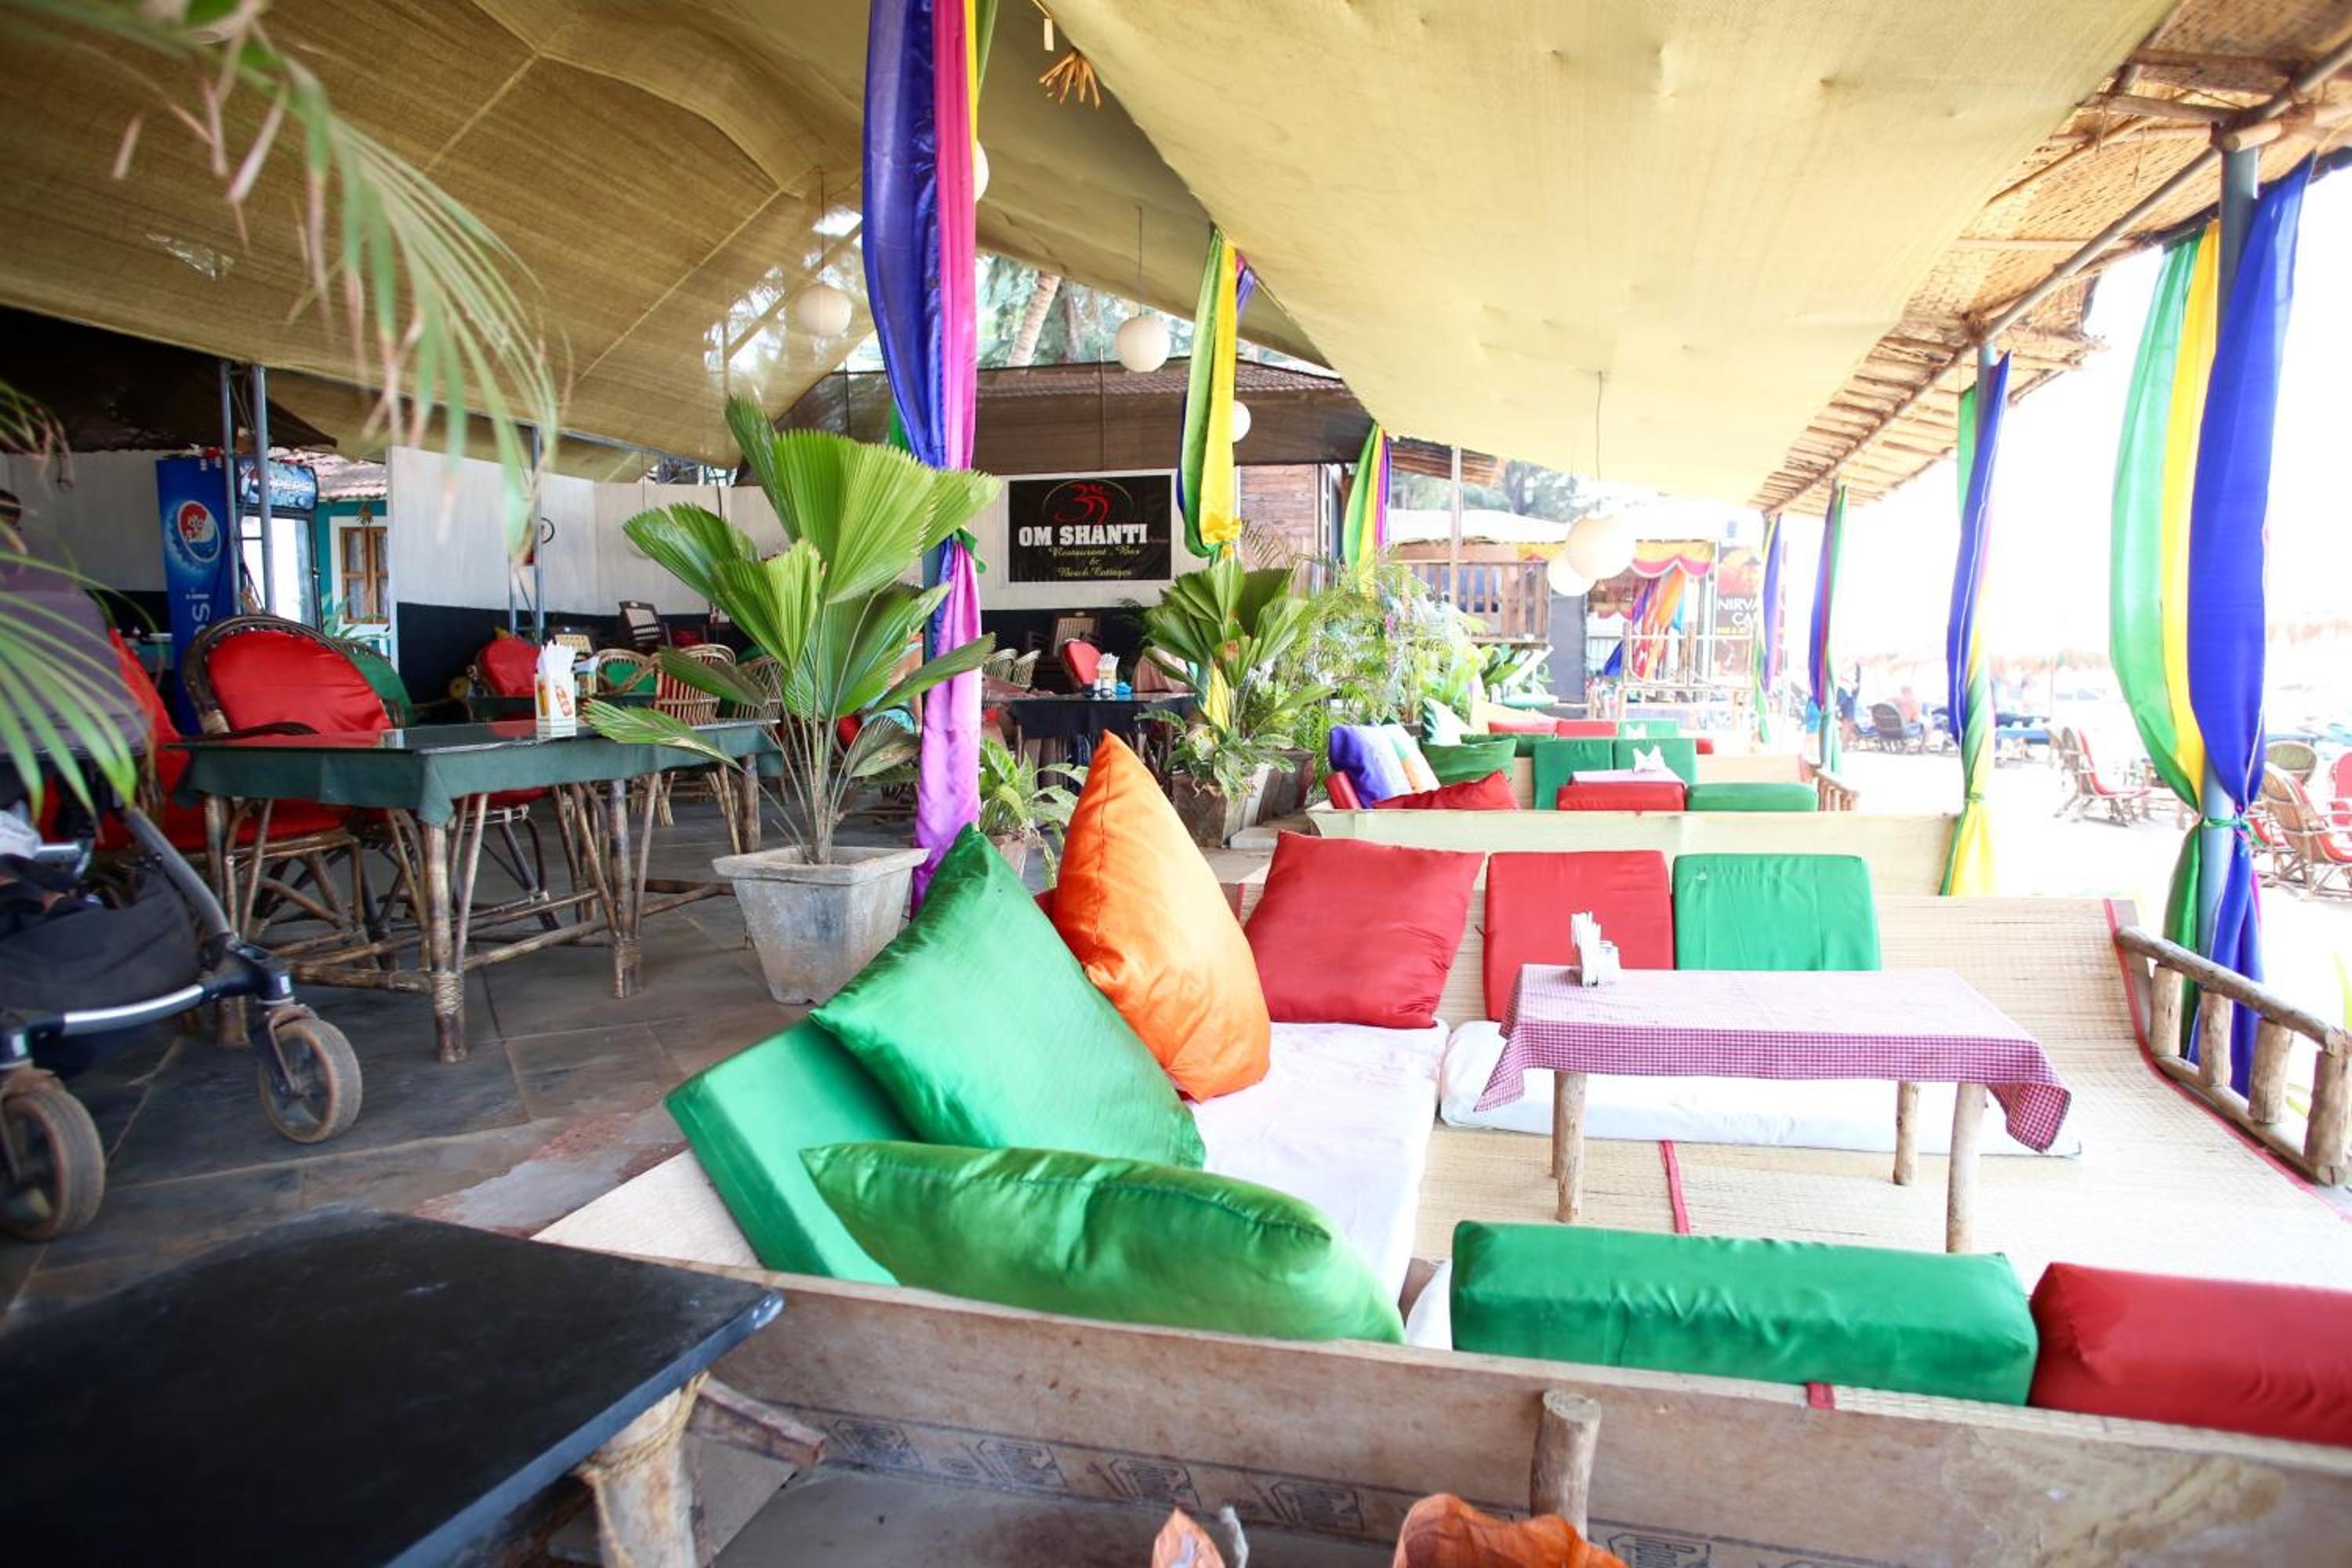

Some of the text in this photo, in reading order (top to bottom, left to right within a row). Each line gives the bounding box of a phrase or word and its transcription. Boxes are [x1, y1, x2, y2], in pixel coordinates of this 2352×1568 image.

[1018, 524, 1148, 546] OM SHANTI
[1049, 546, 1106, 556] Restaurant
[1089, 557, 1102, 565] &
